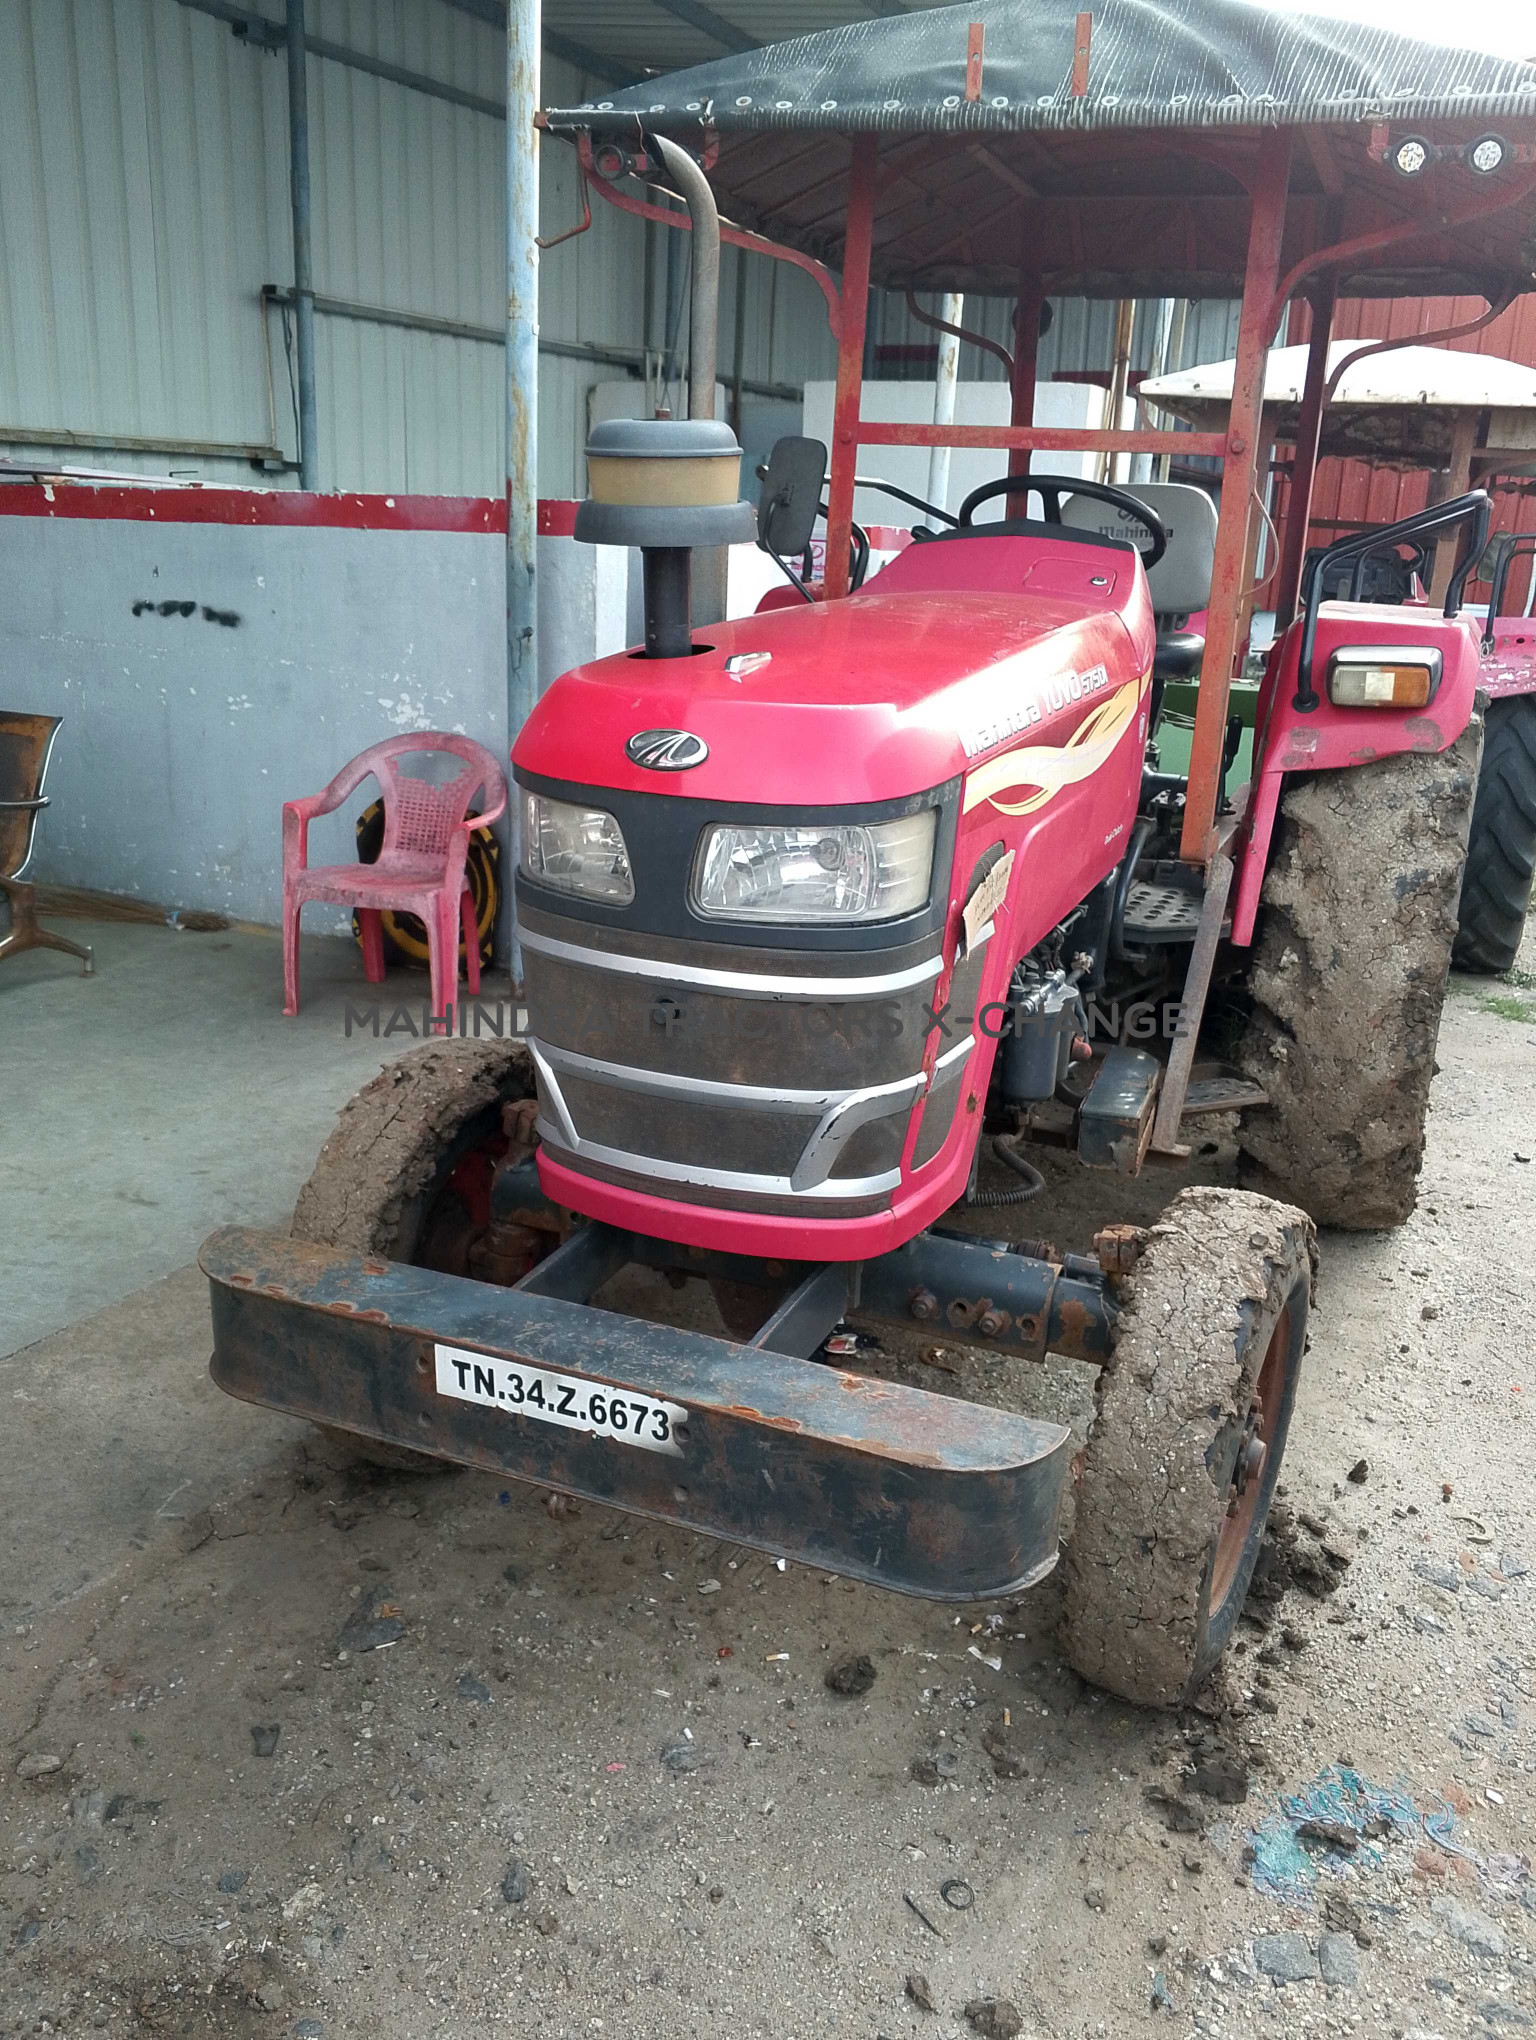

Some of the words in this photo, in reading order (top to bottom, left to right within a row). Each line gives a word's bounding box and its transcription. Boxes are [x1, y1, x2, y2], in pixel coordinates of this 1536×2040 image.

[1098, 526, 1174, 538] Mahina
[1080, 665, 1109, 695] 575DI
[451, 1358, 670, 1442] TN.34.Z.6673
